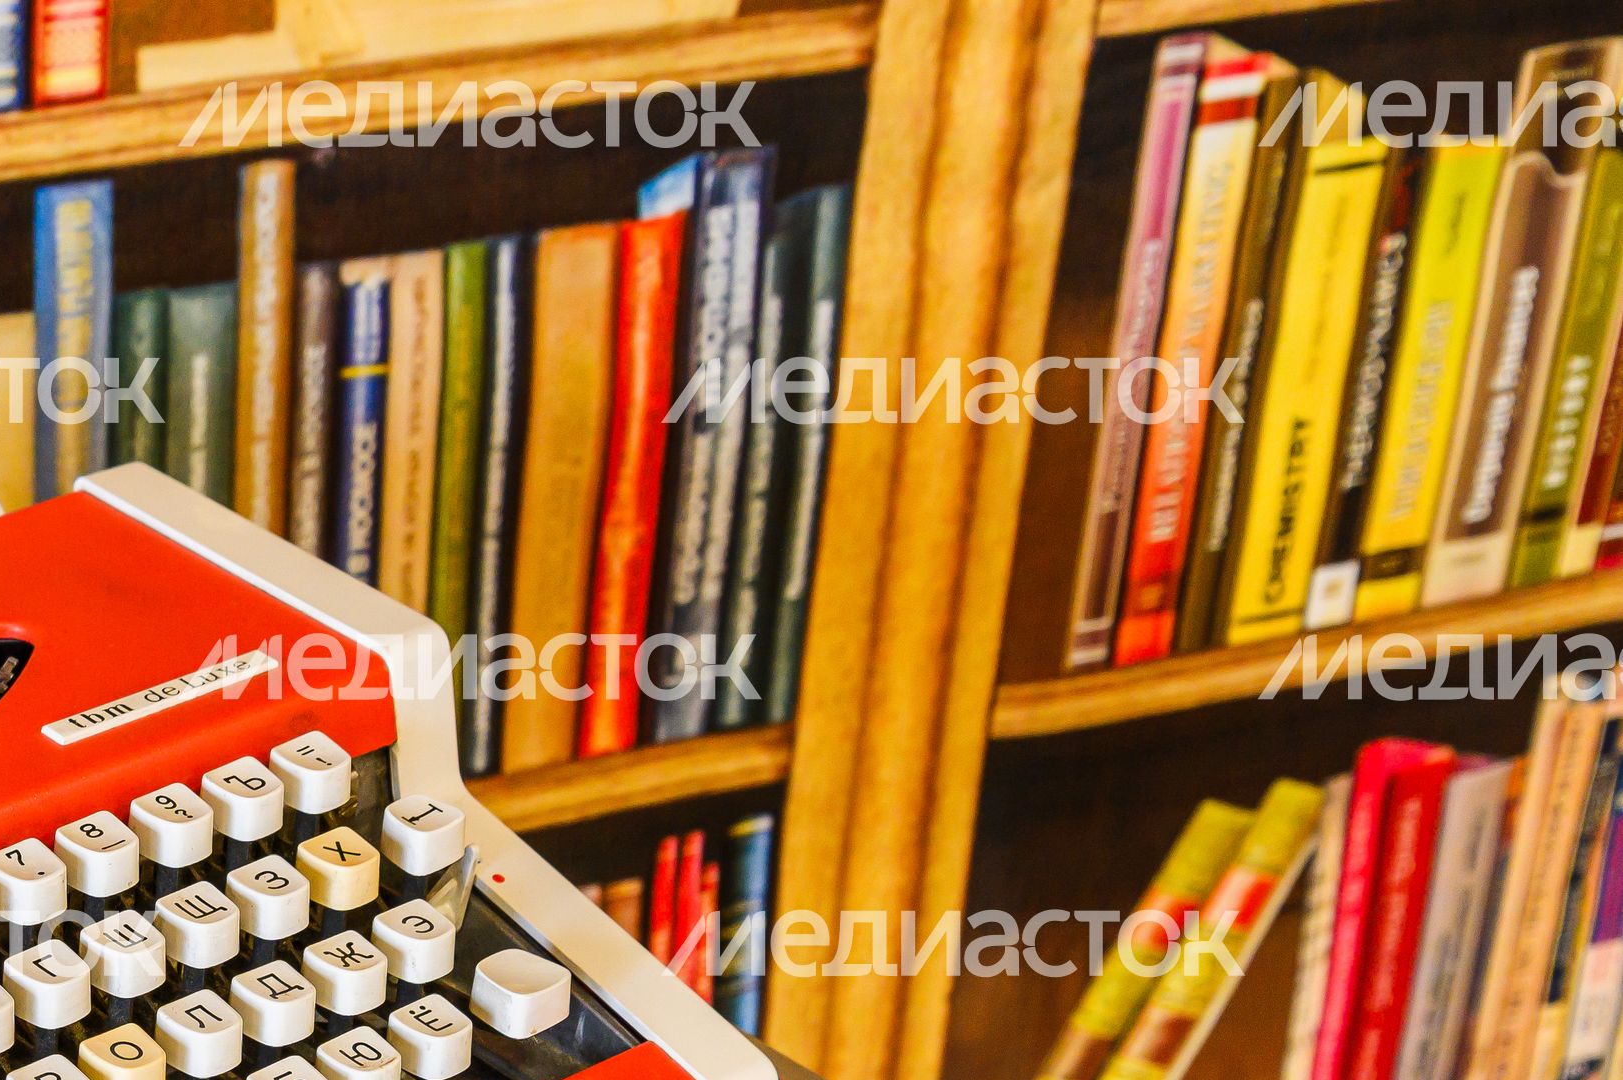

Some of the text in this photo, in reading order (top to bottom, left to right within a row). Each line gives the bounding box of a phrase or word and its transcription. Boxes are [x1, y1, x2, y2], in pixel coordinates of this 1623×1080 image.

[1263, 417, 1311, 606] CHEMISTRY
[68, 659, 251, 729] tbm de Luxe
[223, 774, 267, 792] Ъ
[322, 840, 362, 863] Х
[174, 894, 229, 920] Щ
[103, 922, 149, 949] Ш
[400, 915, 435, 935] Э
[32, 954, 58, 978] Г
[323, 941, 375, 968] Ж
[255, 972, 305, 1000] Д
[184, 1003, 224, 1029] Л
[408, 1004, 454, 1032] Ё
[109, 1040, 145, 1061] О
[338, 1040, 379, 1067] Ю
